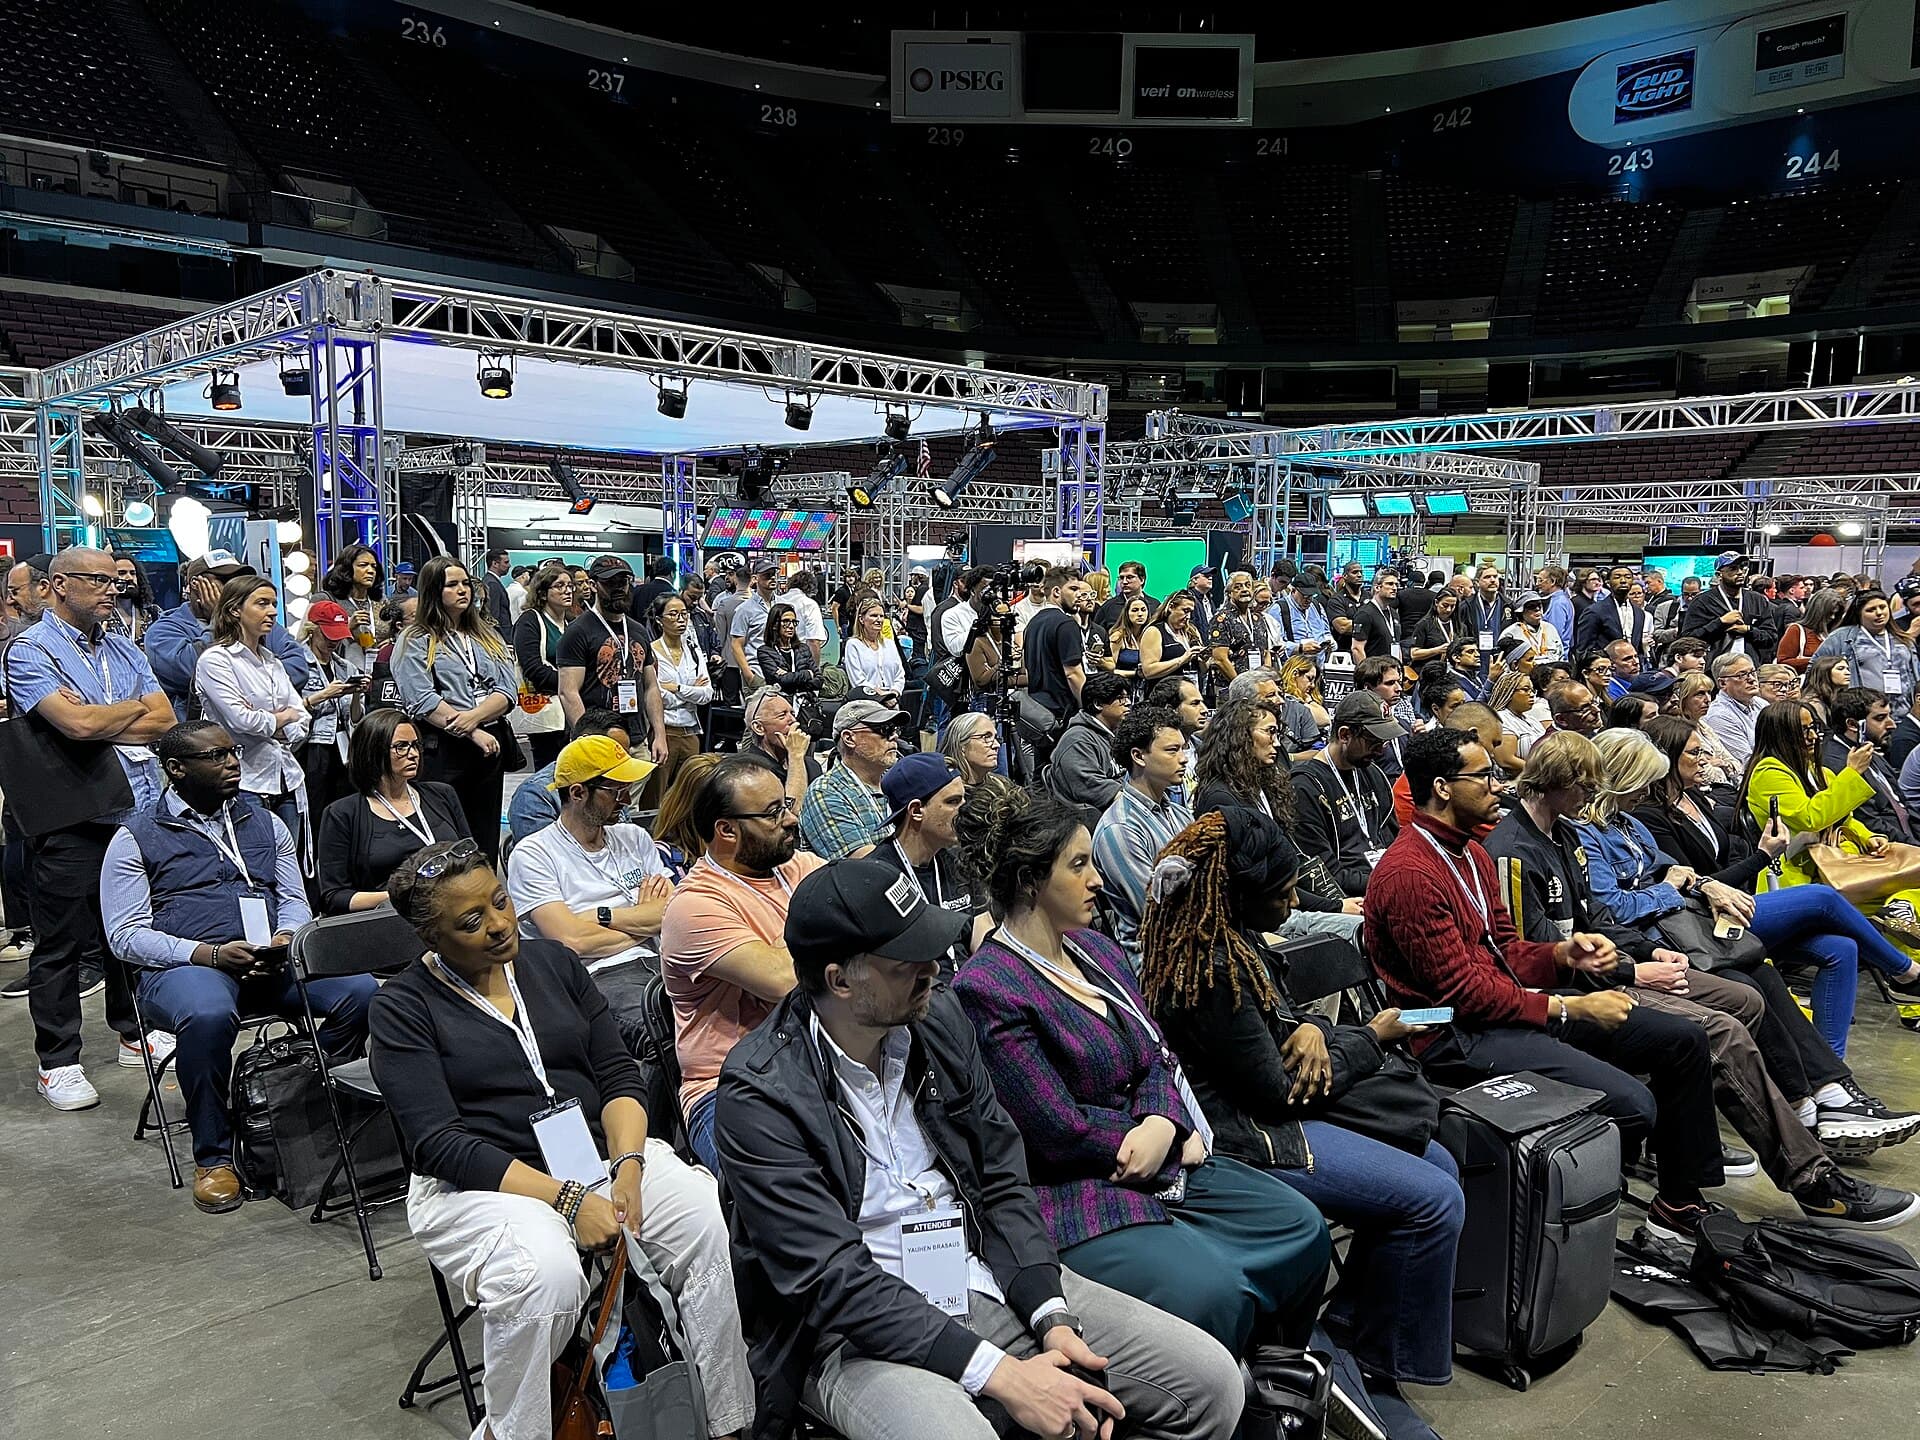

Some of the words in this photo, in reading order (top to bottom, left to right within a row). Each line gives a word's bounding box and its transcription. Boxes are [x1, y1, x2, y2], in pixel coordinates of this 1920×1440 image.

[401, 17, 447, 48] 236
[1776, 42, 1800, 52] Cough
[587, 68, 625, 94] 237
[939, 70, 1004, 91] PSEG
[1632, 68, 1684, 91] BUD
[1618, 81, 1690, 107] LIGHT
[761, 104, 797, 127] 238
[1432, 106, 1472, 133] 242
[927, 126, 965, 147] 239
[1089, 137, 1133, 156] 240
[1256, 137, 1288, 156] 241
[1607, 148, 1654, 176] 243
[1785, 149, 1841, 179] 244
[1328, 682, 1345, 694] NJ
[913, 1220, 952, 1232] ATTENDEE
[907, 1246, 932, 1254] YAUHEN
